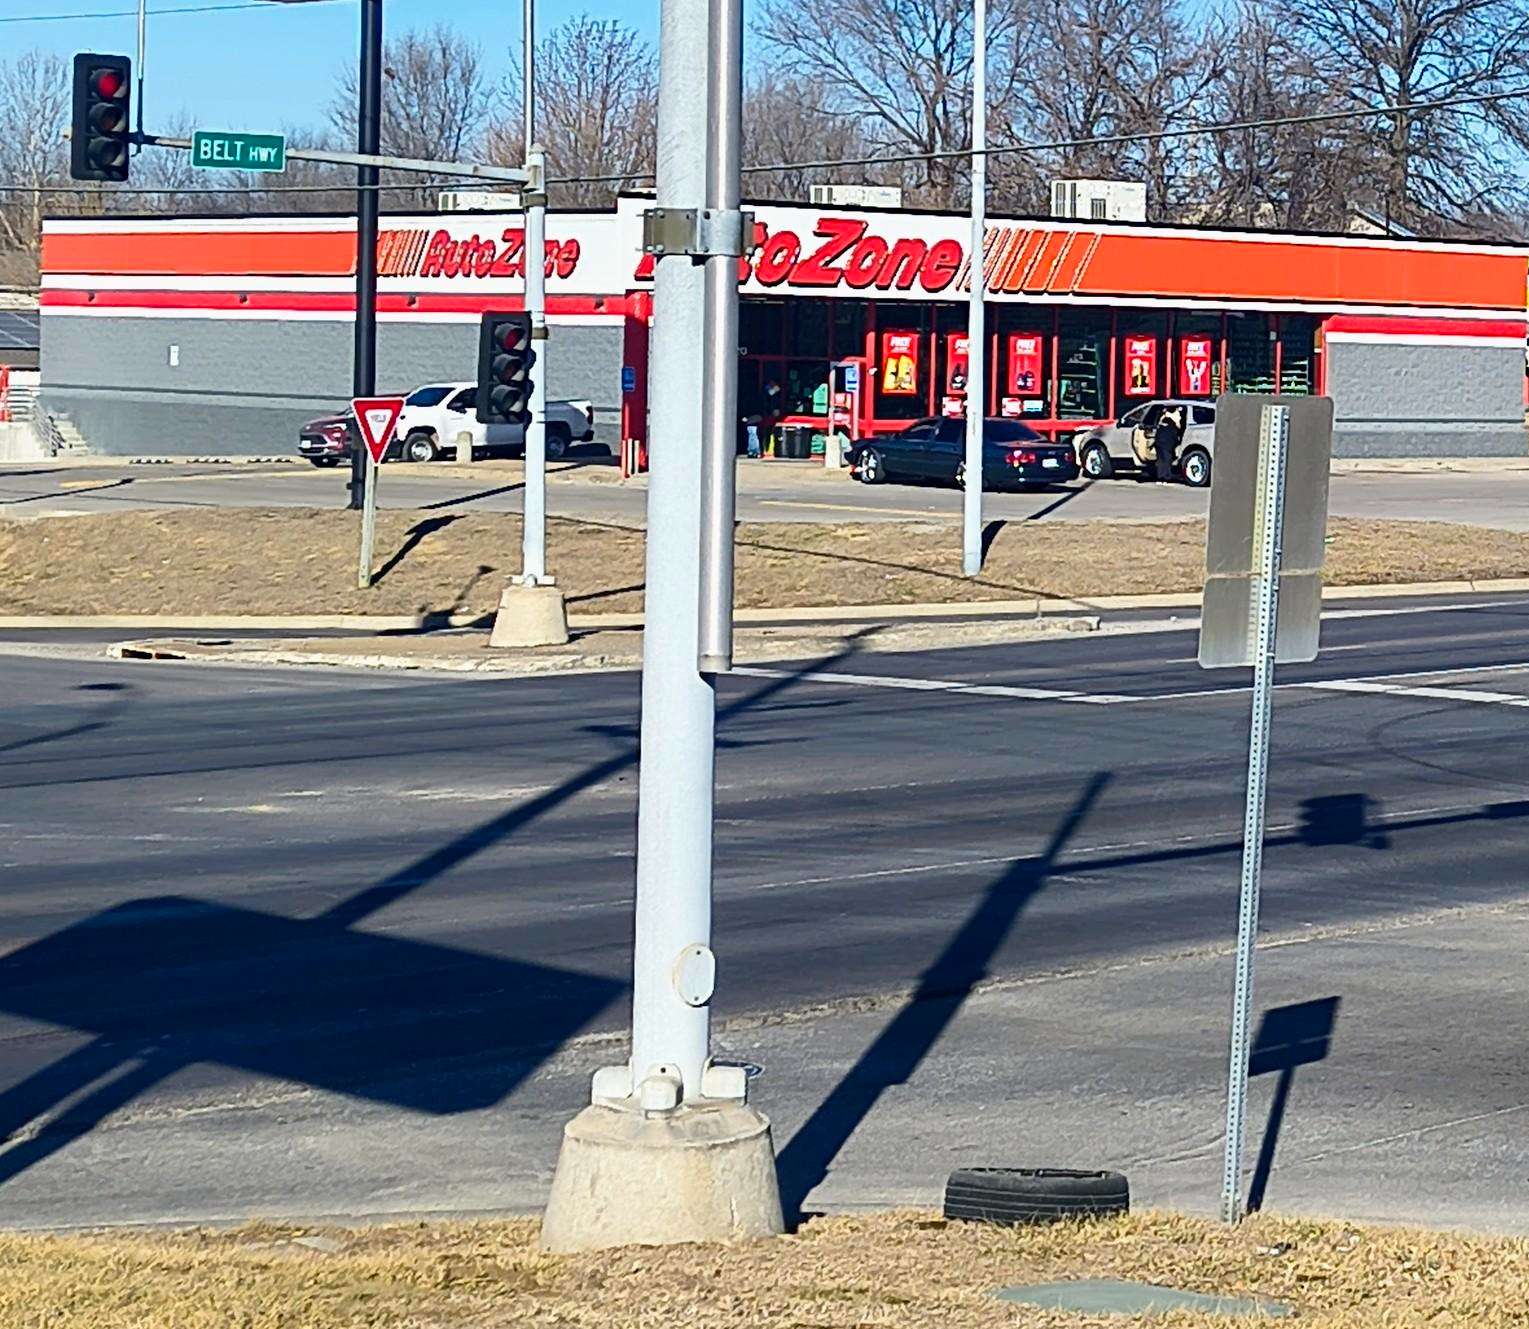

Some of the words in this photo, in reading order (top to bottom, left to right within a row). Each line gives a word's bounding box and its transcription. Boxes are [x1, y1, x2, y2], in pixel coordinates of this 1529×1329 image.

[200, 139, 245, 160] BELT
[249, 146, 278, 162] HWY
[420, 228, 580, 279] AutoZne
[634, 218, 963, 293] toZone
